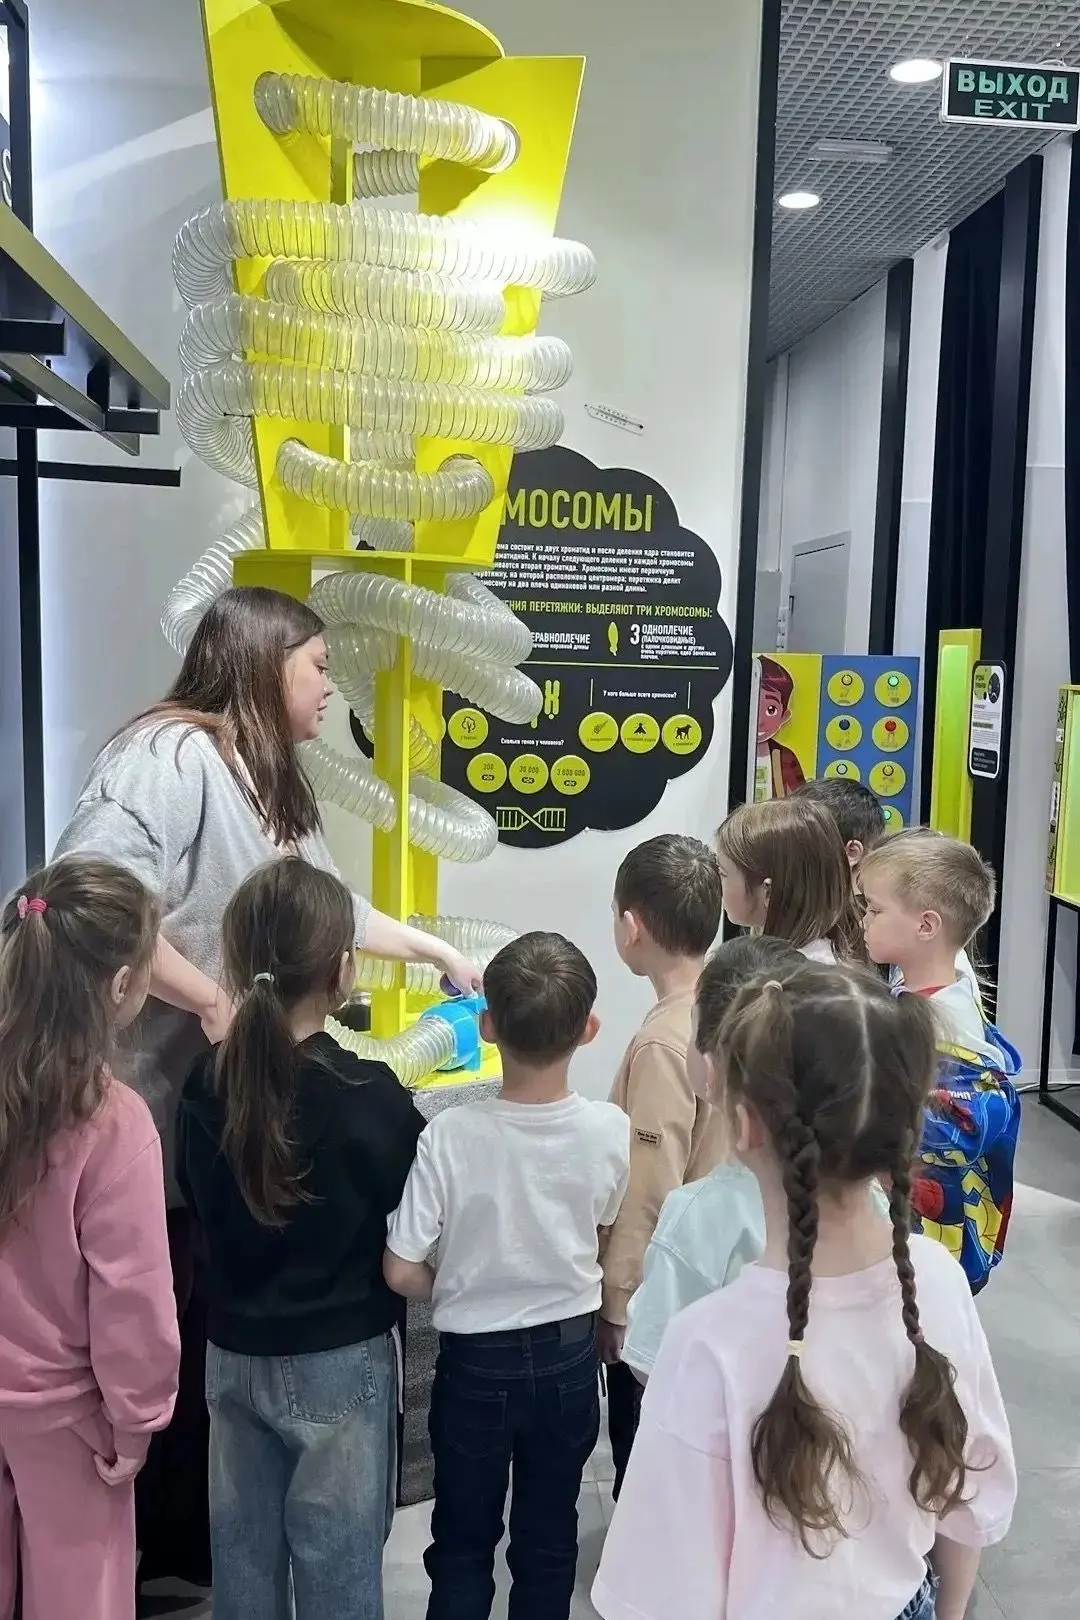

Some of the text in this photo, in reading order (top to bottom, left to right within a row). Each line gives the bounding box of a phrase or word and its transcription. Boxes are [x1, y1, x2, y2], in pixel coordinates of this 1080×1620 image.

[957, 69, 1069, 104] ВЫХОД
[974, 99, 1051, 120] EXIT
[501, 488, 653, 533] МОСОМЫ
[510, 544, 535, 552] состоит
[544, 545, 560, 554] двух
[561, 546, 590, 555] хроматид
[616, 548, 643, 556] деления
[644, 549, 659, 557] ядра
[660, 550, 695, 558] становится
[495, 552, 531, 560] оматидной.
[538, 554, 561, 563] началу
[562, 555, 600, 564] следующего
[601, 557, 628, 565] деления
[628, 558, 633, 566] у
[634, 557, 658, 566] каждой
[659, 559, 694, 567] хромосомы
[520, 563, 542, 571] вторая
[543, 563, 579, 572] хроматида.
[582, 563, 618, 573] Хромосомы
[641, 567, 675, 577] первичную
[519, 571, 544, 580] которой
[545, 573, 587, 581] расположена
[628, 576, 662, 585] перетяжка
[663, 577, 682, 585] делит
[508, 580, 516, 588] на
[517, 581, 530, 589] два
[530, 581, 549, 589] плеча
[550, 582, 587, 590] одинаковой
[588, 583, 600, 591] или
[601, 584, 624, 592] разной
[624, 585, 648, 593] длины.
[529, 600, 583, 614] ПЕРЕТЯЖКИ:
[585, 602, 634, 616] ВЫДЕЛЯЮТ
[636, 605, 652, 616] ТРИ
[654, 605, 713, 618] ХРОМОСОМЫ:
[629, 623, 640, 645] 3
[641, 624, 694, 636] ОДНОПЛЕЧИЕ
[530, 631, 591, 645] ЕРАВНОПЛЕЧИЕ
